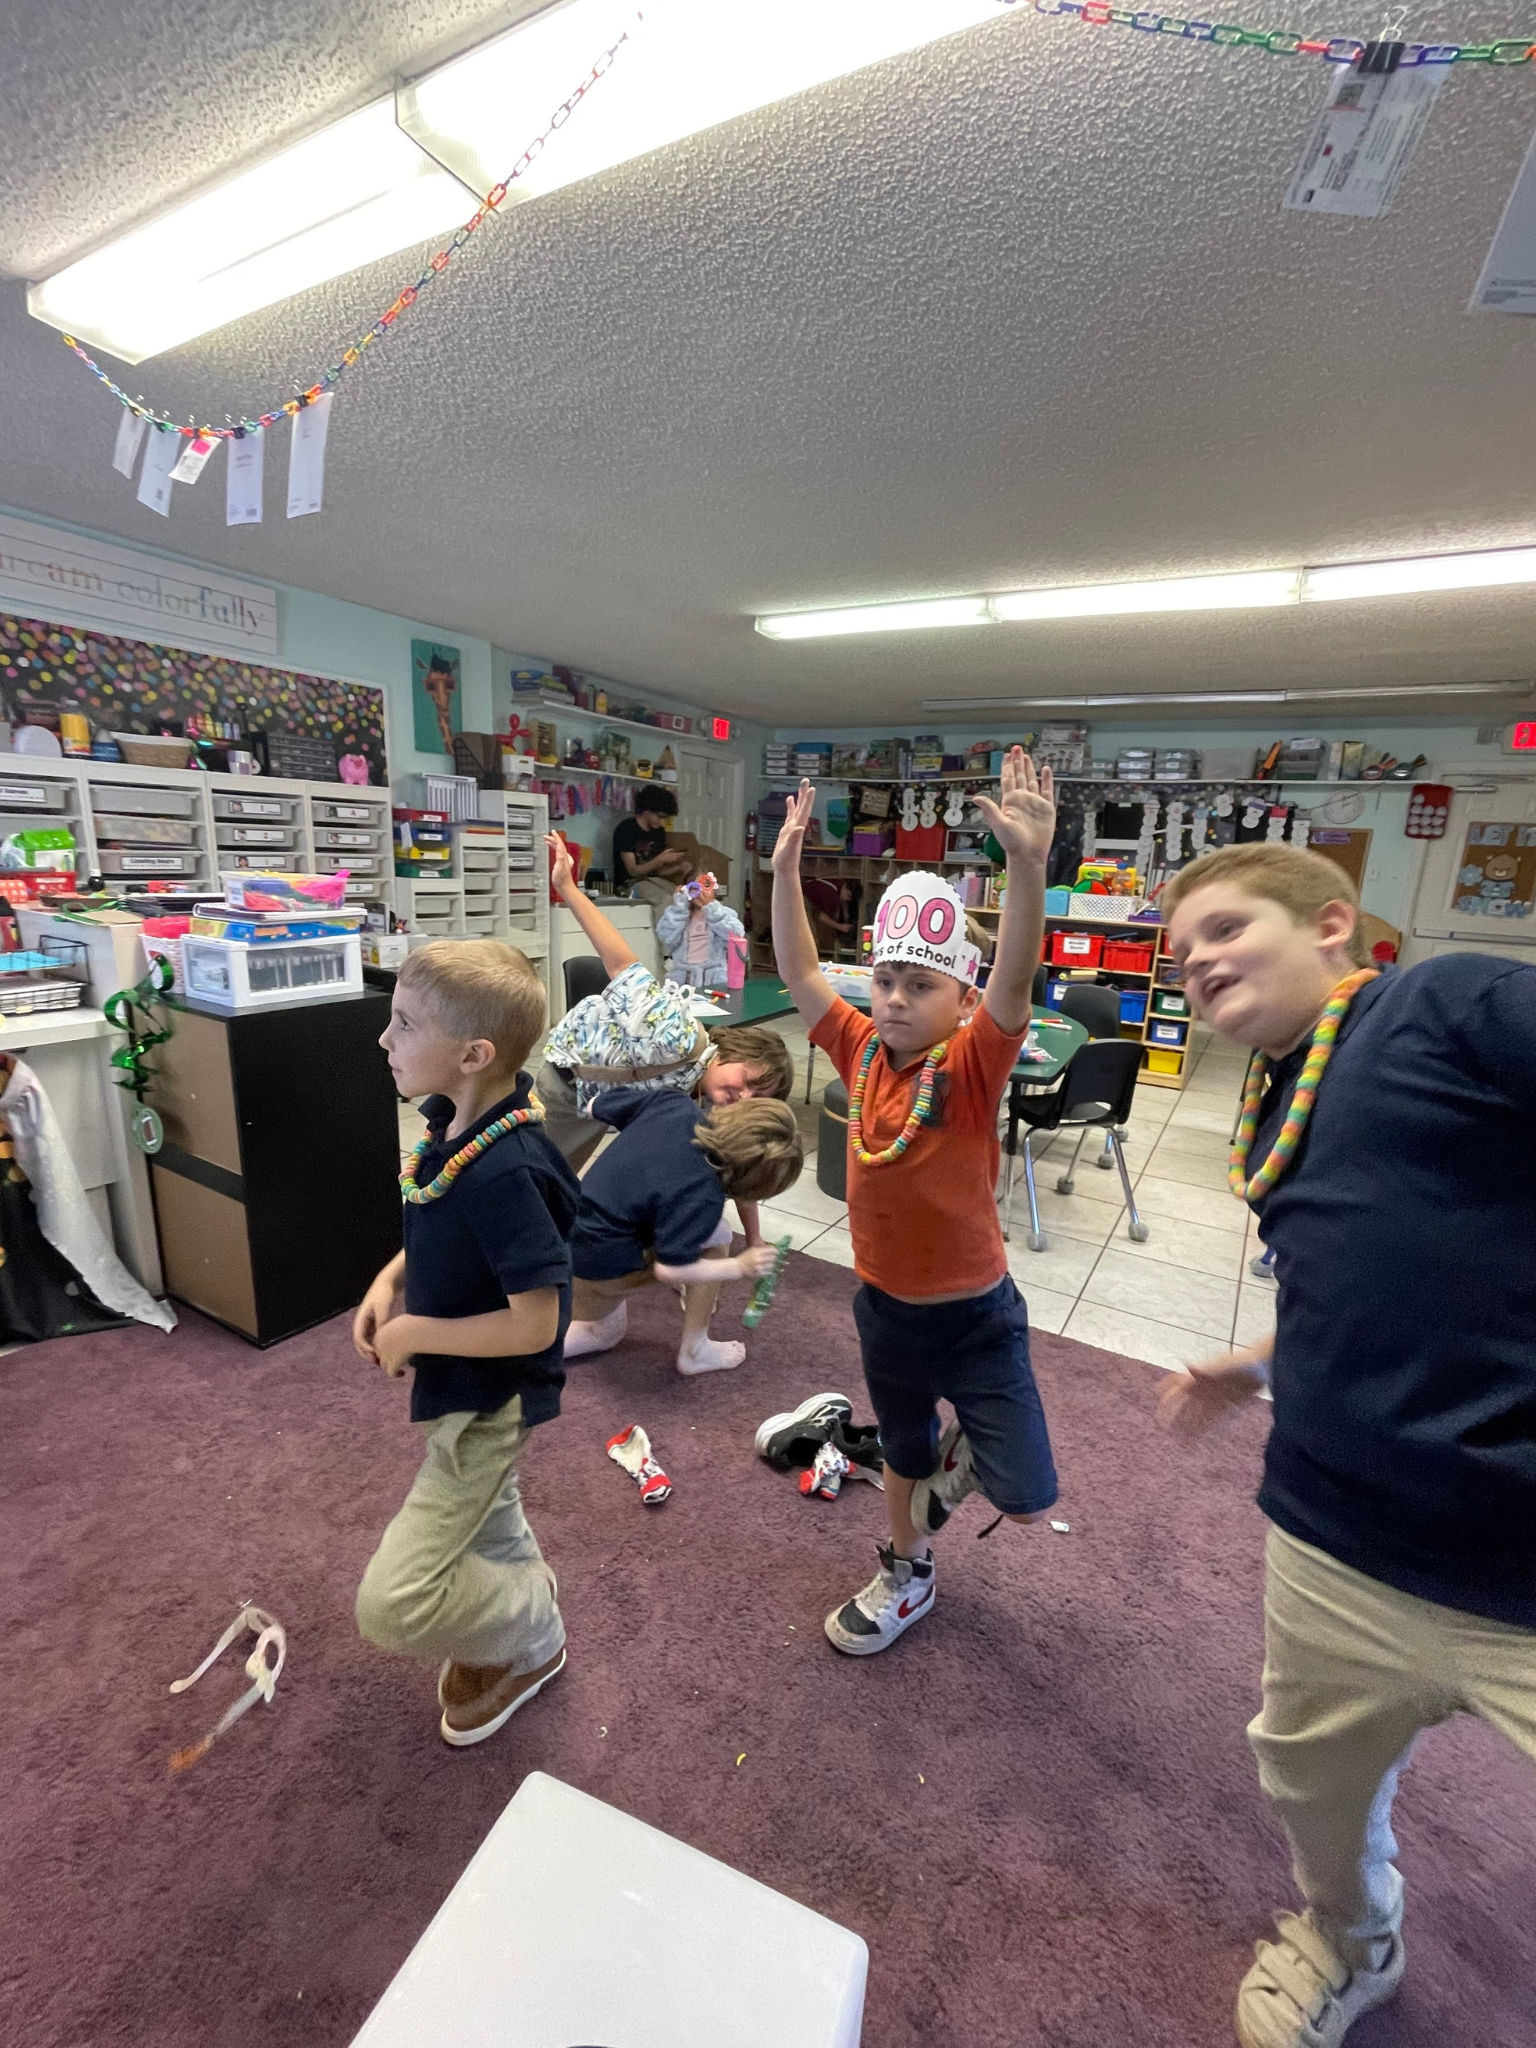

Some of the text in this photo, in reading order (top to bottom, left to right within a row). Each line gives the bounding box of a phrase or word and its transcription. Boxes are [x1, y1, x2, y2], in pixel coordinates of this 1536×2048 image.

[117, 574, 266, 637] colorfully
[1468, 824, 1515, 847] LET
[877, 894, 956, 945] 100
[1458, 895, 1532, 918] SNOW
[887, 941, 903, 954] of
[906, 945, 957, 969] school
